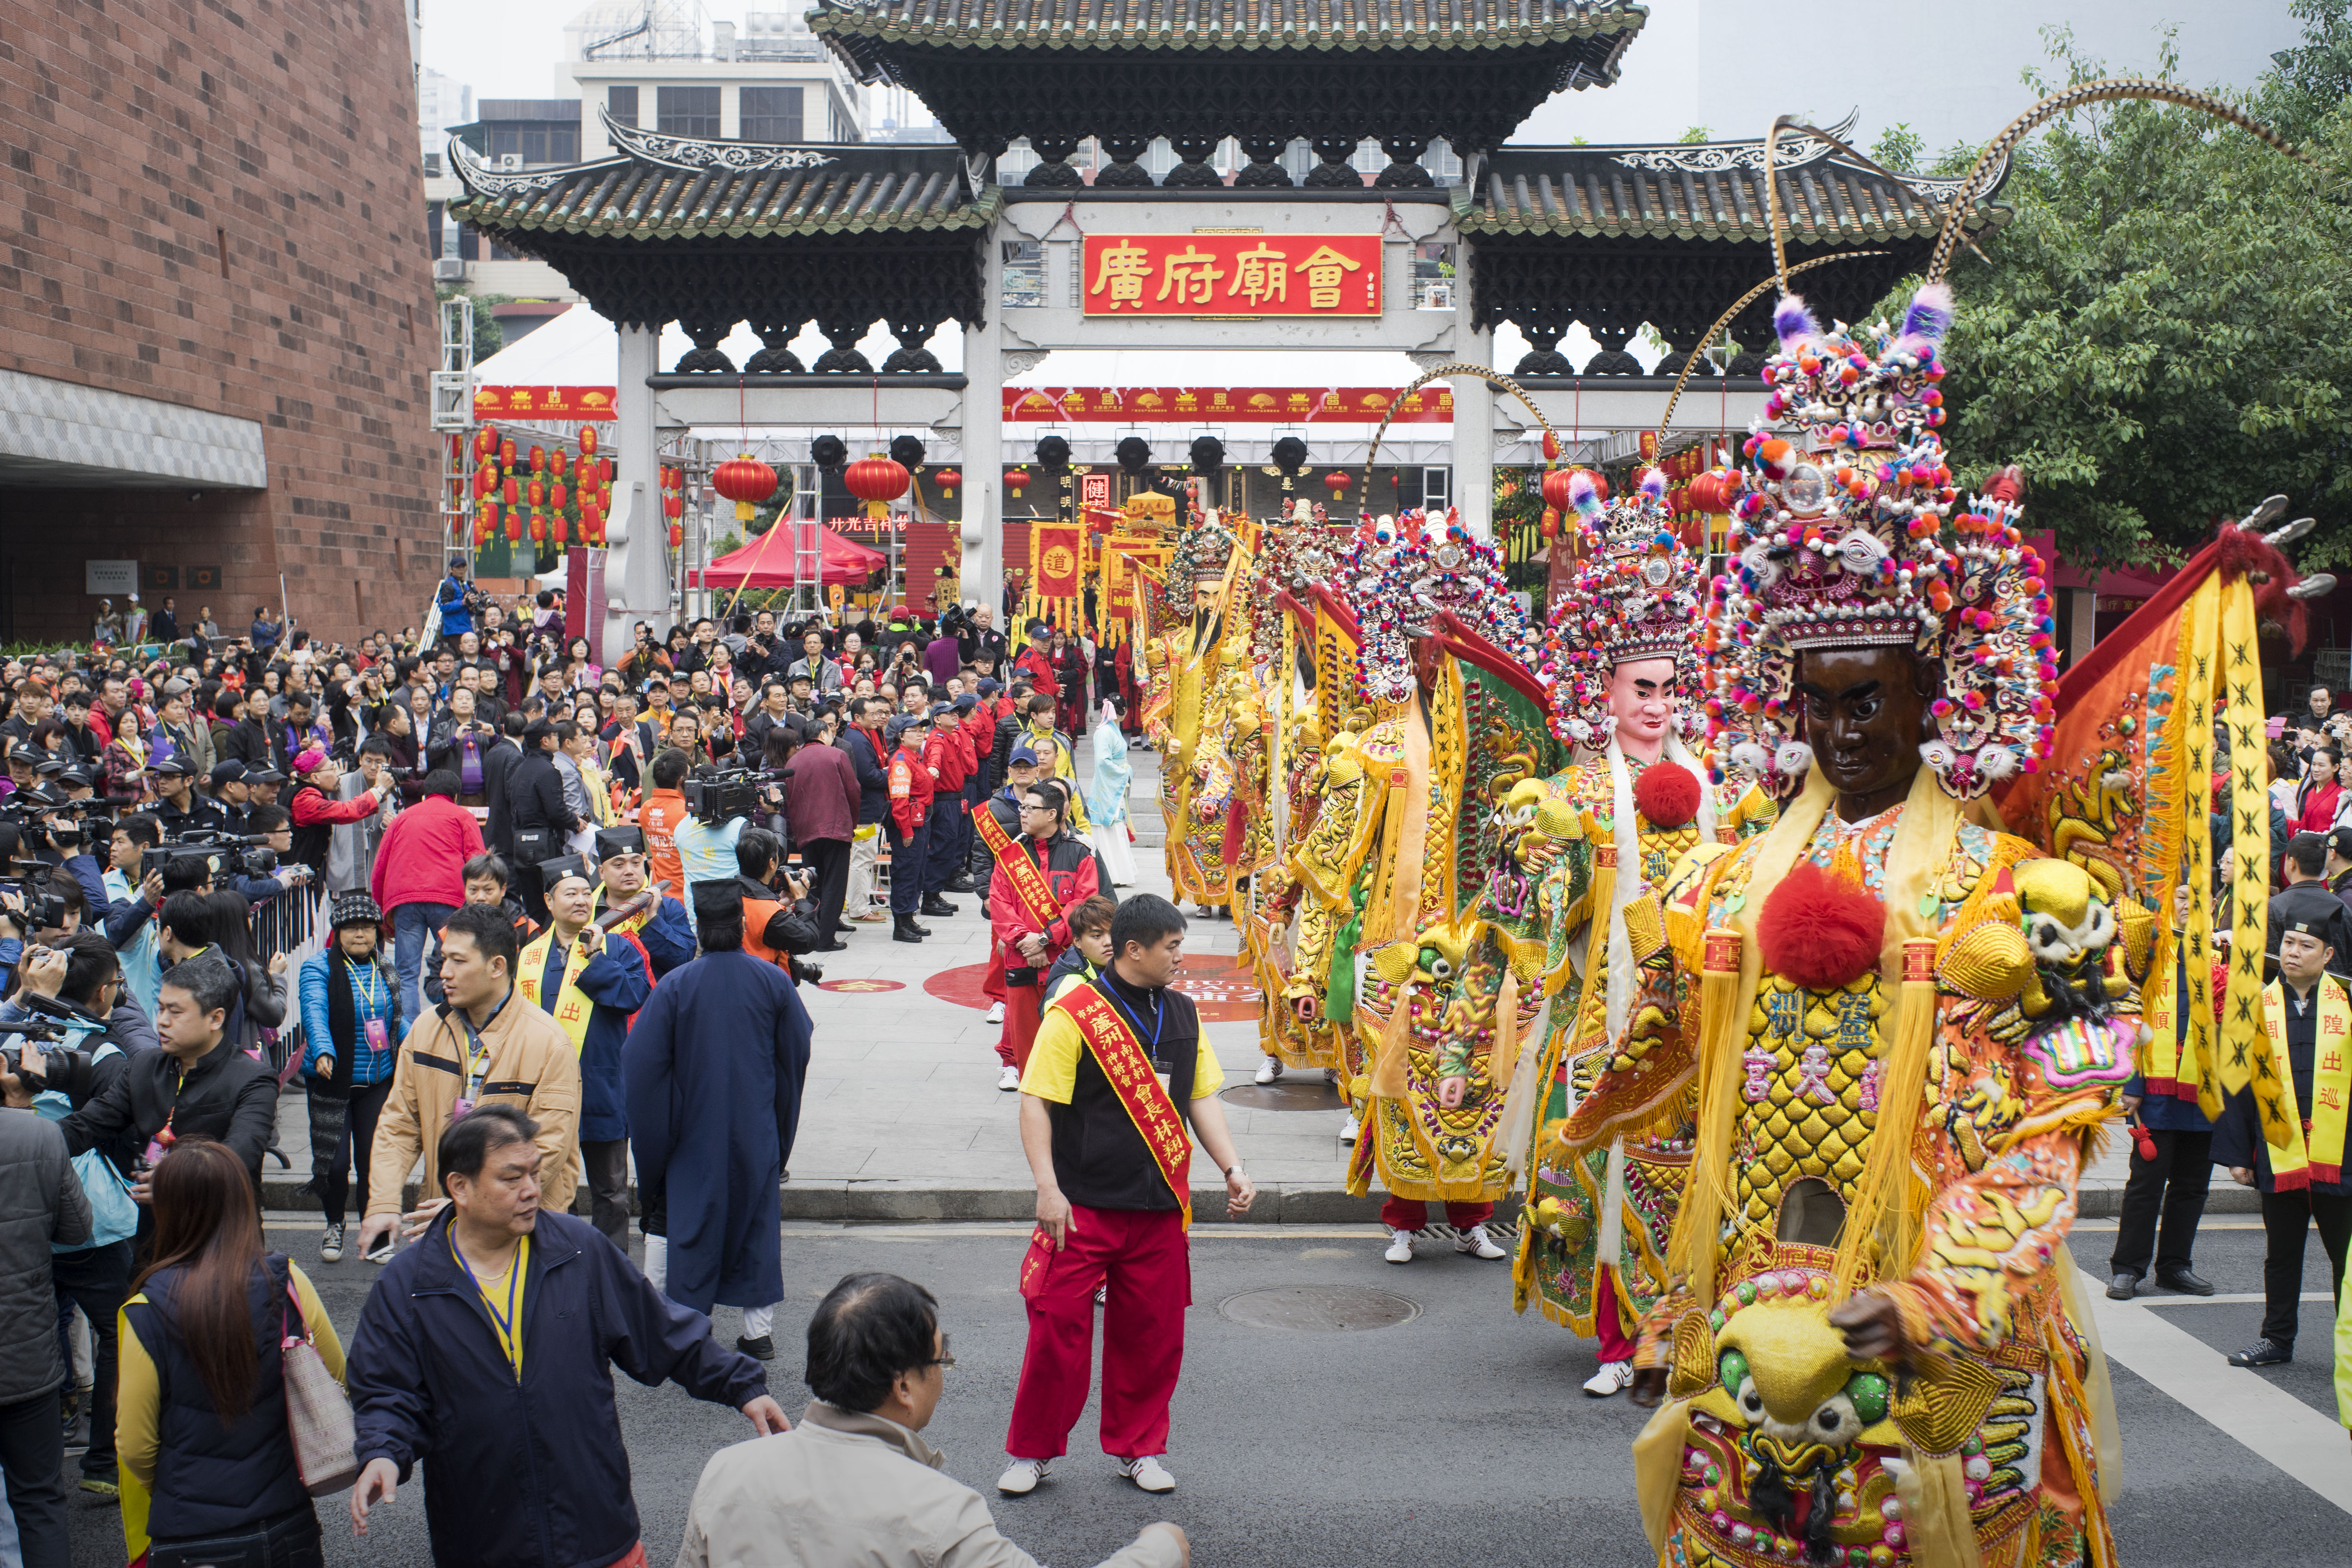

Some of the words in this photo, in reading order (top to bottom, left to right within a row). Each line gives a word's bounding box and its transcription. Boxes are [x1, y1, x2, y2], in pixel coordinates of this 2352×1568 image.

[1090, 239, 1361, 309] 廣府廟會
[1046, 552, 1069, 573] 道
[1076, 999, 1105, 1019] 新北市
[1089, 1012, 1125, 1050] 蘆洲
[2318, 985, 2348, 1110] 城隍出巡
[1106, 1052, 1132, 1088] 神將會
[1120, 1043, 1145, 1080] 南義軒
